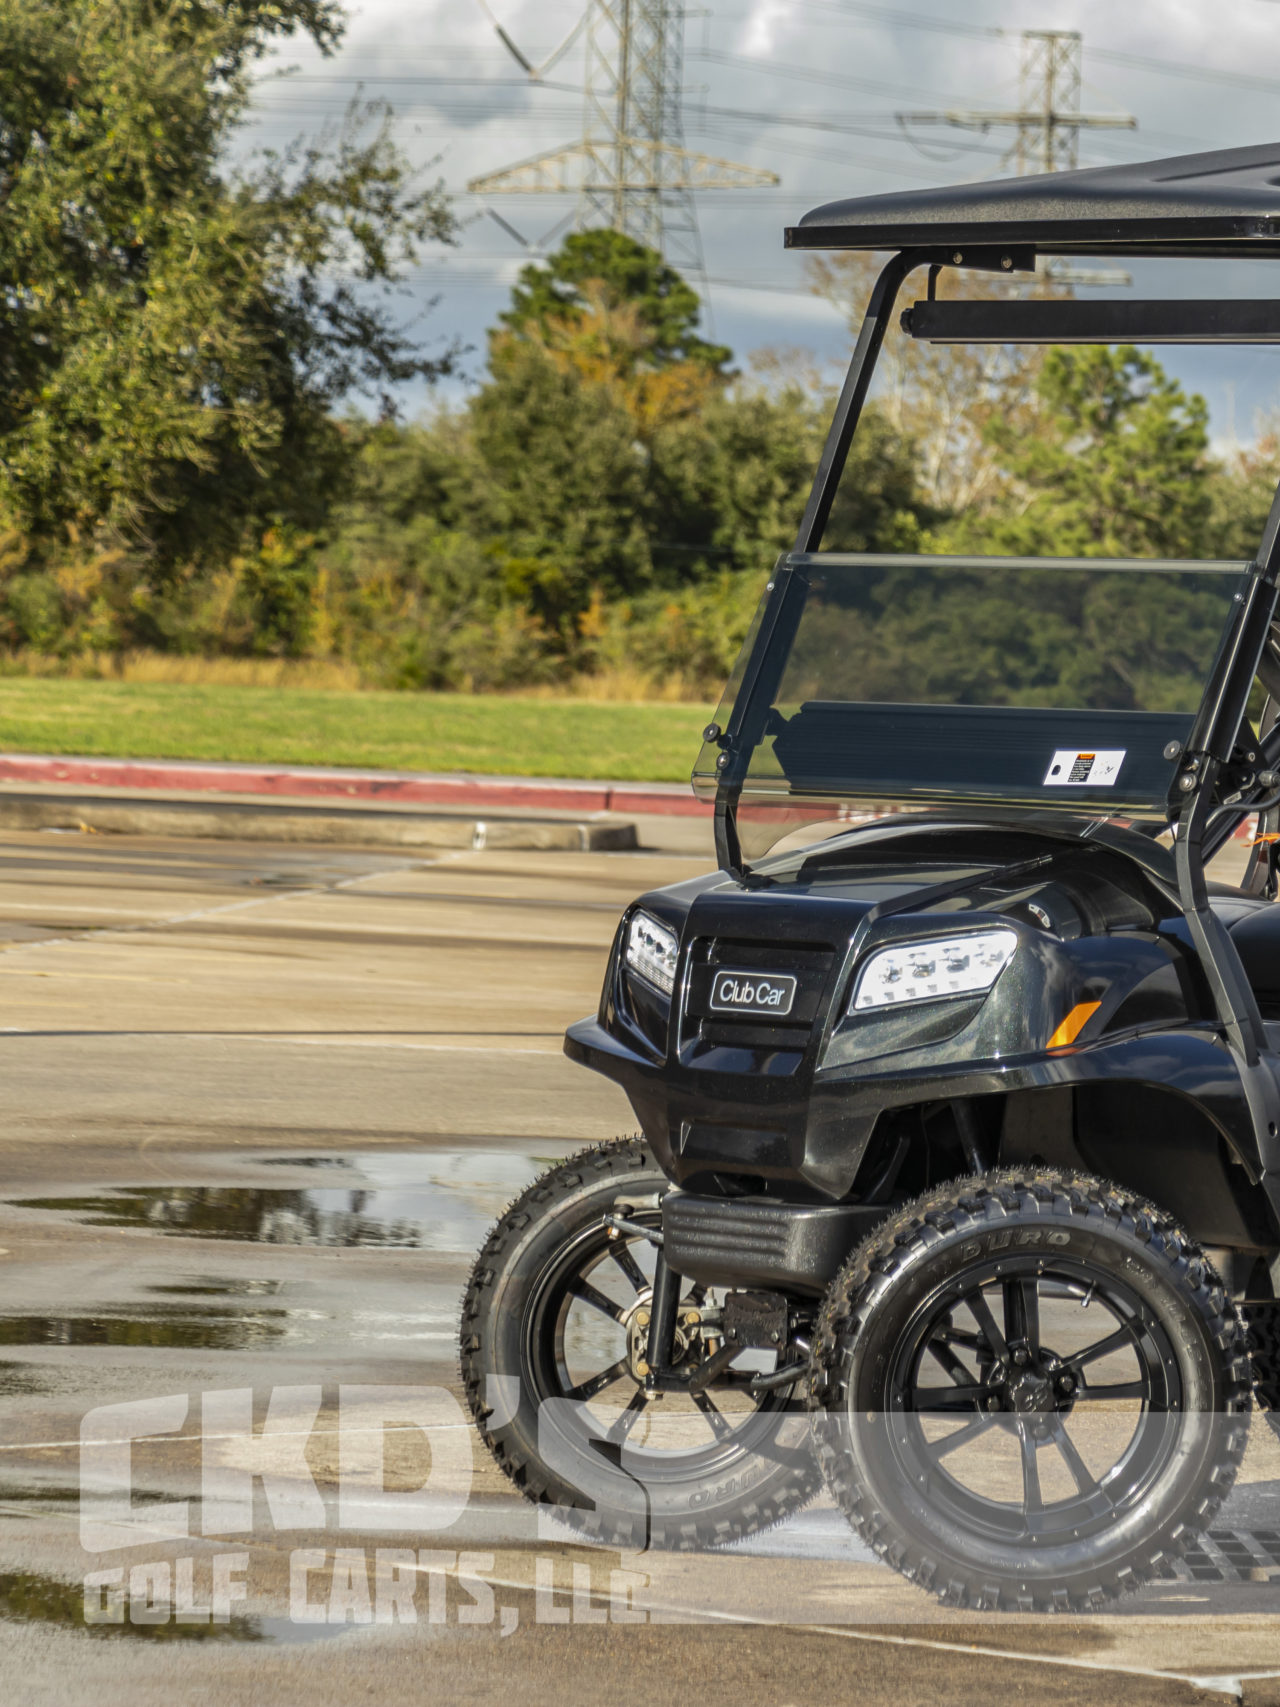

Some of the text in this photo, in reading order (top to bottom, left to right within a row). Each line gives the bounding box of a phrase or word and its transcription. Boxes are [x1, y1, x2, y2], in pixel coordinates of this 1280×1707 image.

[720, 980, 785, 1006] Club Car
[961, 1230, 1072, 1262] DURO
